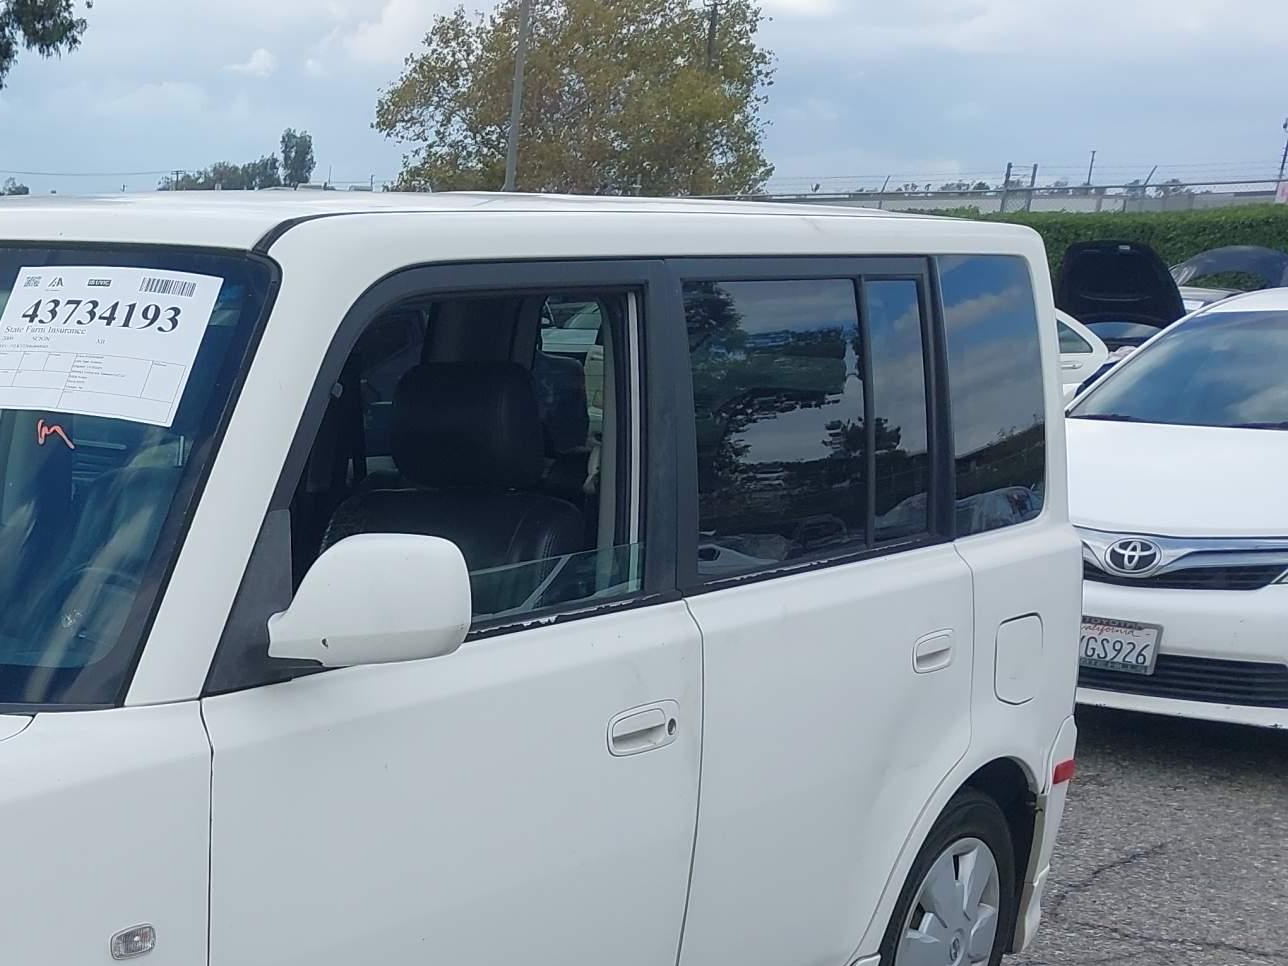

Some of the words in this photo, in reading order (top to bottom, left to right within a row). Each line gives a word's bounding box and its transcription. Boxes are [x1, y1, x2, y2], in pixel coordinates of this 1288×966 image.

[22, 298, 181, 333] 43734193
[25, 325, 47, 333] Farm
[48, 326, 87, 335] Insurance
